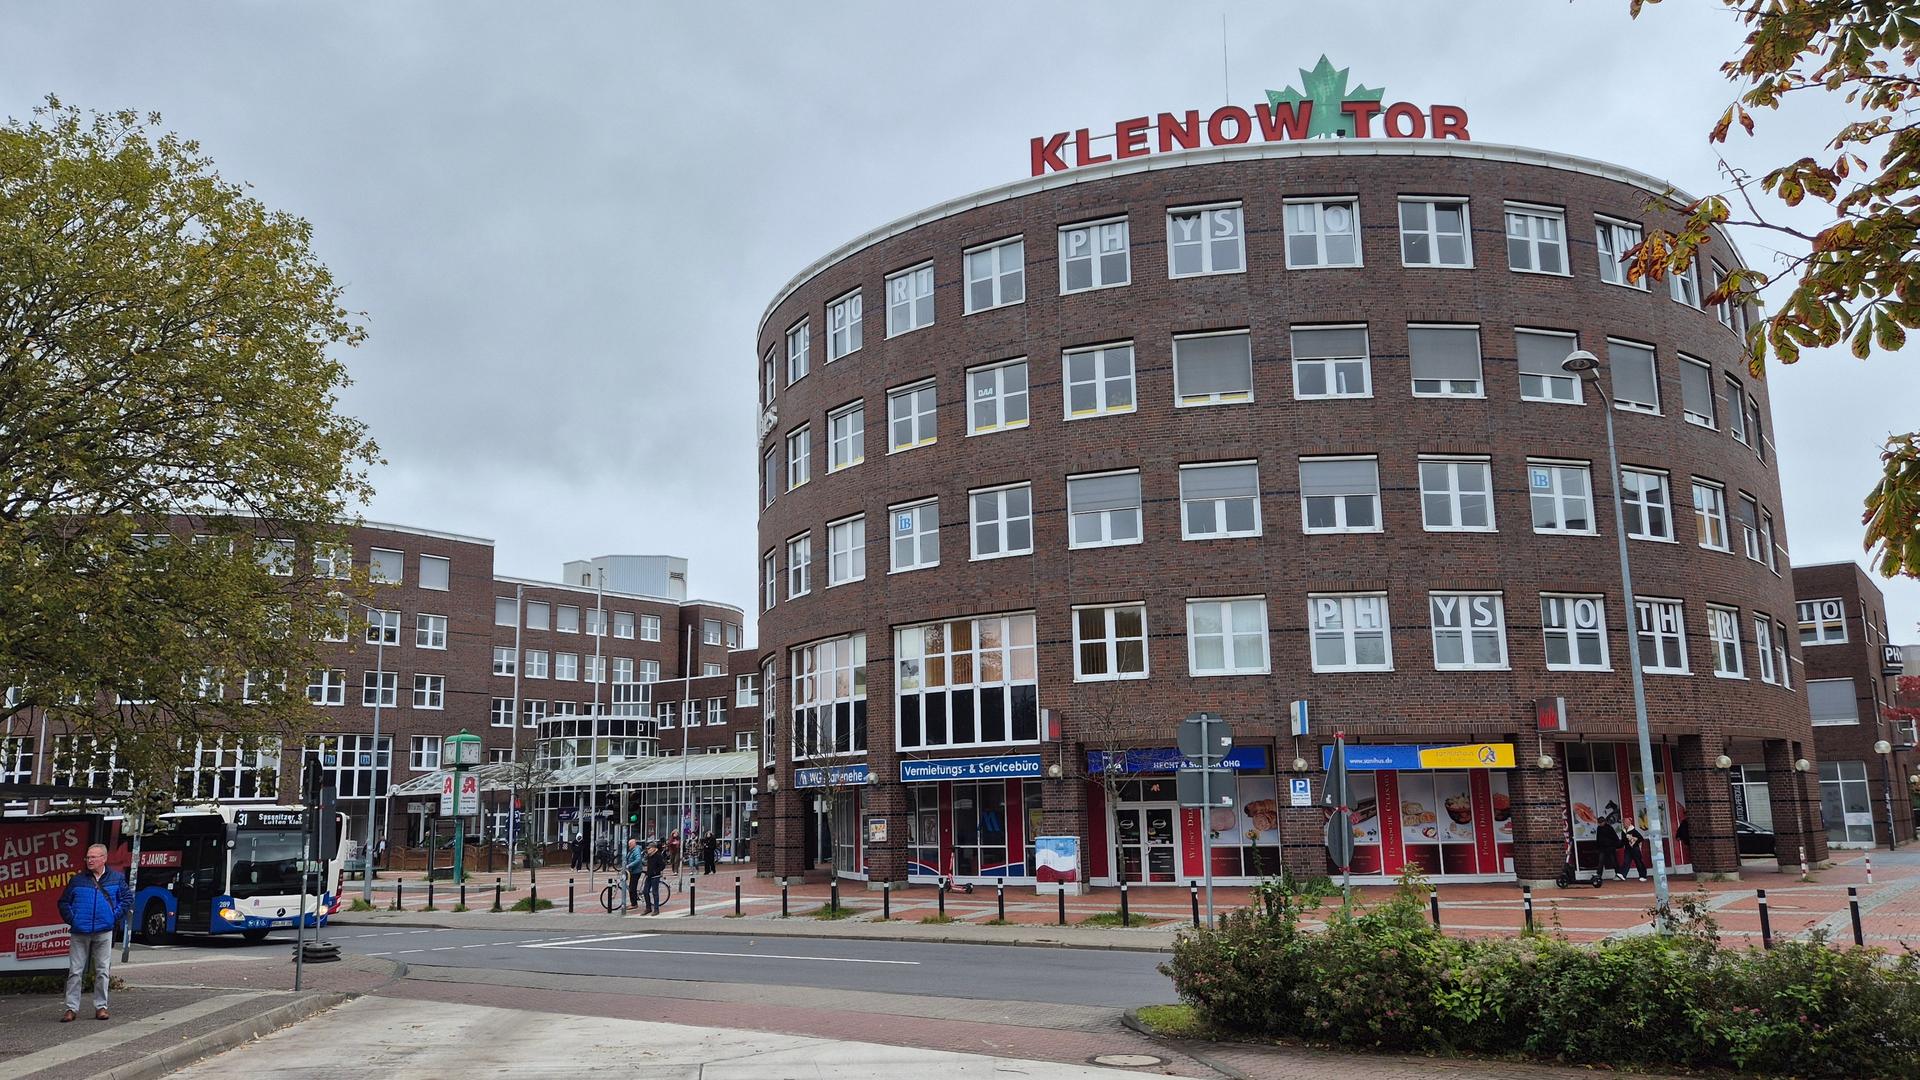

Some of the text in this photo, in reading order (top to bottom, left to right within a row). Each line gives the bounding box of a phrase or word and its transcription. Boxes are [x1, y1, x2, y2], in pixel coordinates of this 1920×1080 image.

[1030, 100, 1470, 176] KLENOW TOR
[905, 760, 1039, 777] Vermietungs- & Servicebüro
[1296, 781, 1305, 792] P
[237, 813, 248, 825] 31
[0, 828, 78, 860] ÄUFT'S
[36, 853, 73, 874] DIR.
[147, 853, 168, 865] JAHRE
